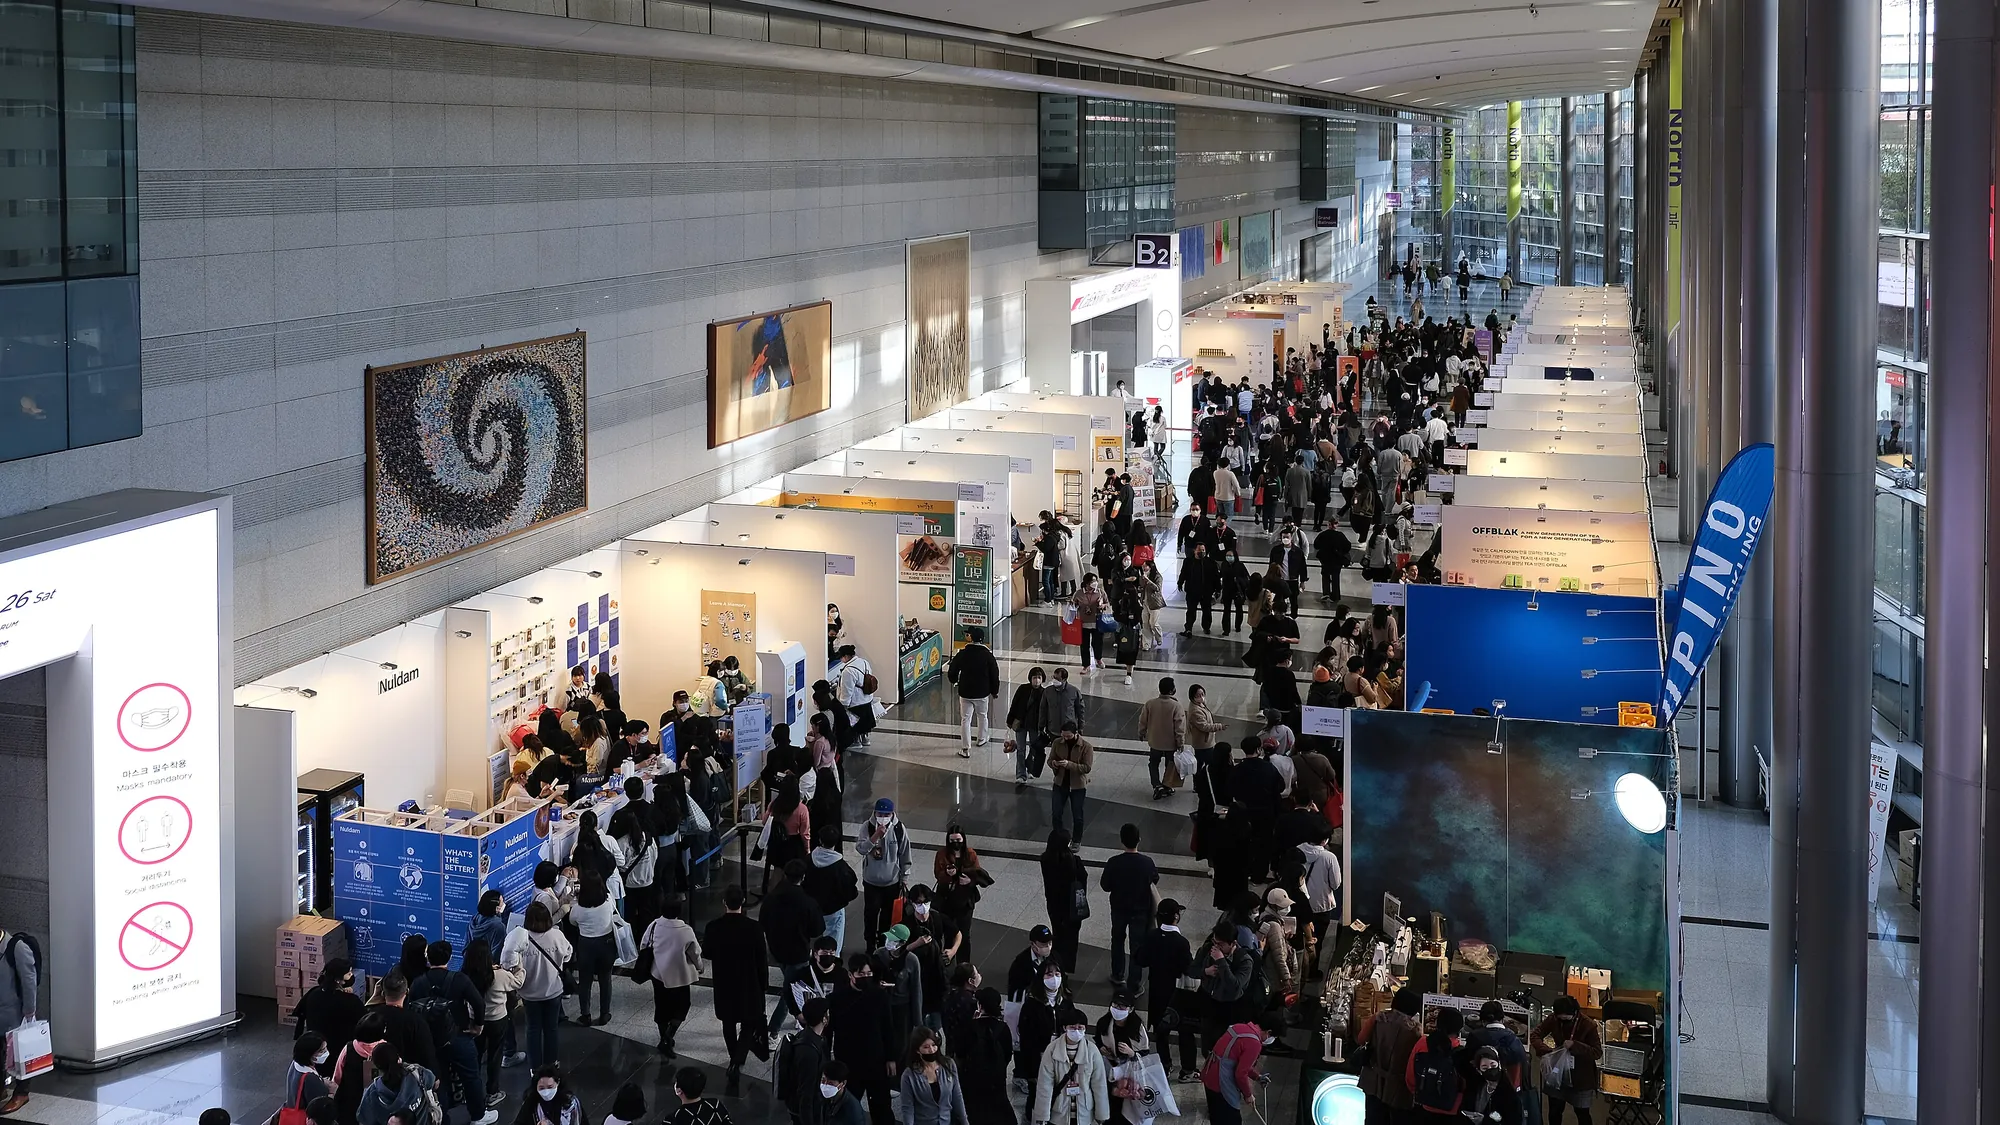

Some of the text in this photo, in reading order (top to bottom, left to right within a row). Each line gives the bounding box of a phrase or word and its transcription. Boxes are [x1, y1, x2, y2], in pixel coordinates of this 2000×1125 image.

[1444, 128, 1453, 160] North
[1509, 128, 1519, 160] North
[1669, 109, 1682, 187] North
[1137, 239, 1169, 265] B2
[1472, 527, 1518, 536] OFFBLAK
[965, 567, 982, 578] 나무
[0, 588, 57, 613] 26 Sat
[378, 667, 419, 695] Nuldam
[122, 759, 187, 778] 마스크 필수착용
[116, 772, 193, 792] Masks mandatory
[340, 826, 361, 834] Nuldam
[505, 831, 528, 849] Nuldam
[444, 848, 473, 859] WHAT'S
[444, 856, 460, 864] THE
[141, 870, 171, 882] 거리두기
[444, 863, 475, 874] BETTER?
[125, 877, 187, 896] Social distancing
